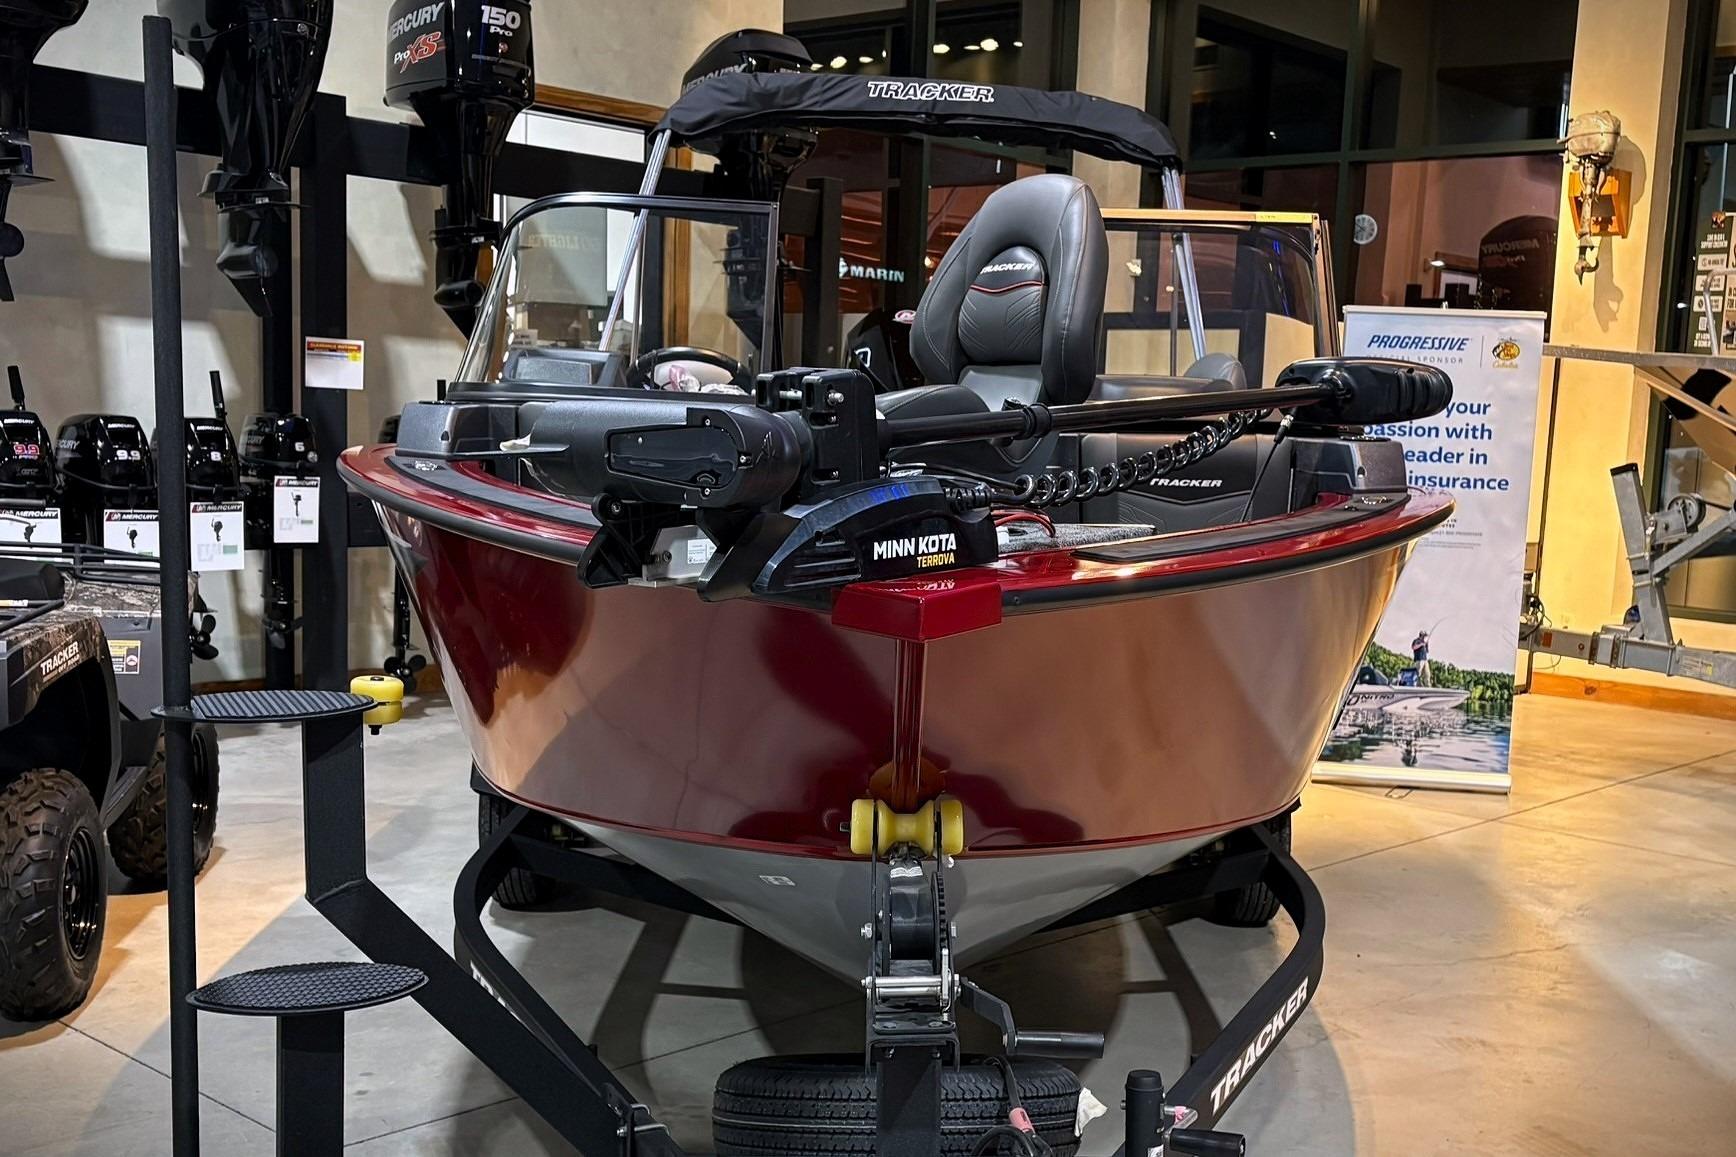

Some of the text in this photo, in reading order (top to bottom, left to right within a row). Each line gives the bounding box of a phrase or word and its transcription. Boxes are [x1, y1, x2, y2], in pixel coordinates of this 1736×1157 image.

[390, 2, 445, 40] ERCURY
[481, 5, 521, 29] 150
[490, 26, 513, 37] Pro
[867, 81, 995, 103] TRACKER
[1367, 335, 1470, 352] PROGRESSIVE
[1417, 355, 1464, 365] SPONSOR
[1446, 401, 1491, 418] your
[1445, 423, 1492, 440] with
[116, 449, 141, 461] 9.9
[1404, 446, 1488, 465] eader in
[1149, 478, 1223, 488] TRACKER
[1408, 470, 1510, 491] insurance
[15, 510, 58, 518] MERCURY
[873, 533, 957, 561] MINN KOTA
[916, 552, 955, 569] TERROVA
[40, 641, 79, 676] TRACKER
[1210, 976, 1309, 1117] TRACKER
